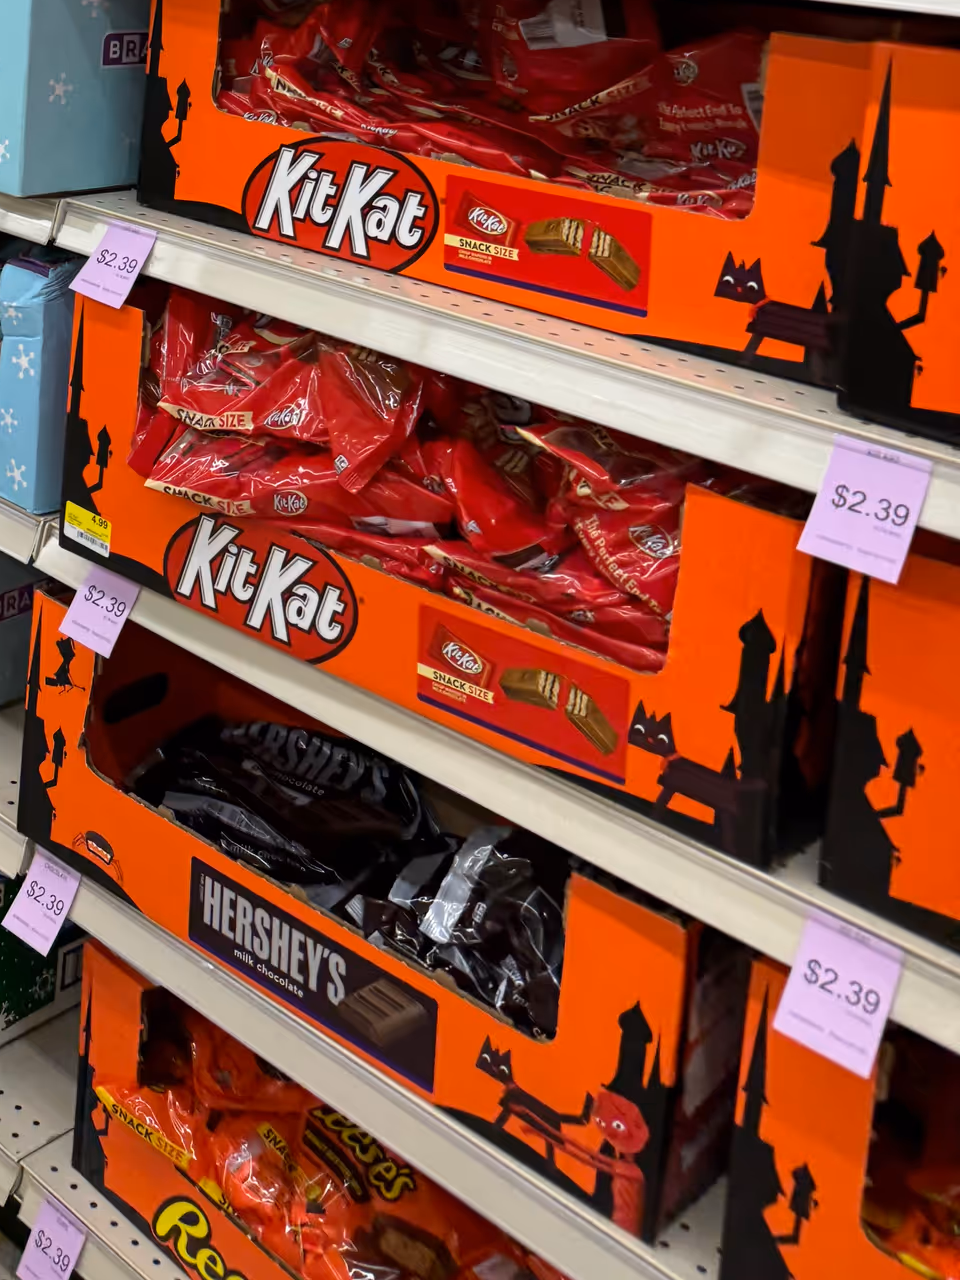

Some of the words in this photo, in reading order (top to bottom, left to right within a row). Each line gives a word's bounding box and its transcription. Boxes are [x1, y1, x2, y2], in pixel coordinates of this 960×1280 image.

[96, 248, 138, 274] $2.39
[459, 237, 492, 253] SNACK
[493, 244, 515, 258] SIZE
[218, 413, 246, 429] SIZE
[90, 515, 109, 530] 4.99
[830, 484, 911, 528] $2.39
[586, 513, 602, 542] The
[594, 530, 629, 584] Perfect
[84, 584, 128, 618] $2.39
[433, 670, 467, 692] SNACK
[467, 685, 490, 701] SIZE
[27, 880, 65, 916] $2.39
[202, 874, 347, 1007] HERSHEY'S
[233, 948, 255, 969] milk
[256, 962, 305, 999] chocolate
[803, 959, 882, 1015] $2.39
[111, 1102, 155, 1145] SNACK
[155, 1136, 188, 1165] SIZE
[34, 1228, 72, 1273] $2.39
